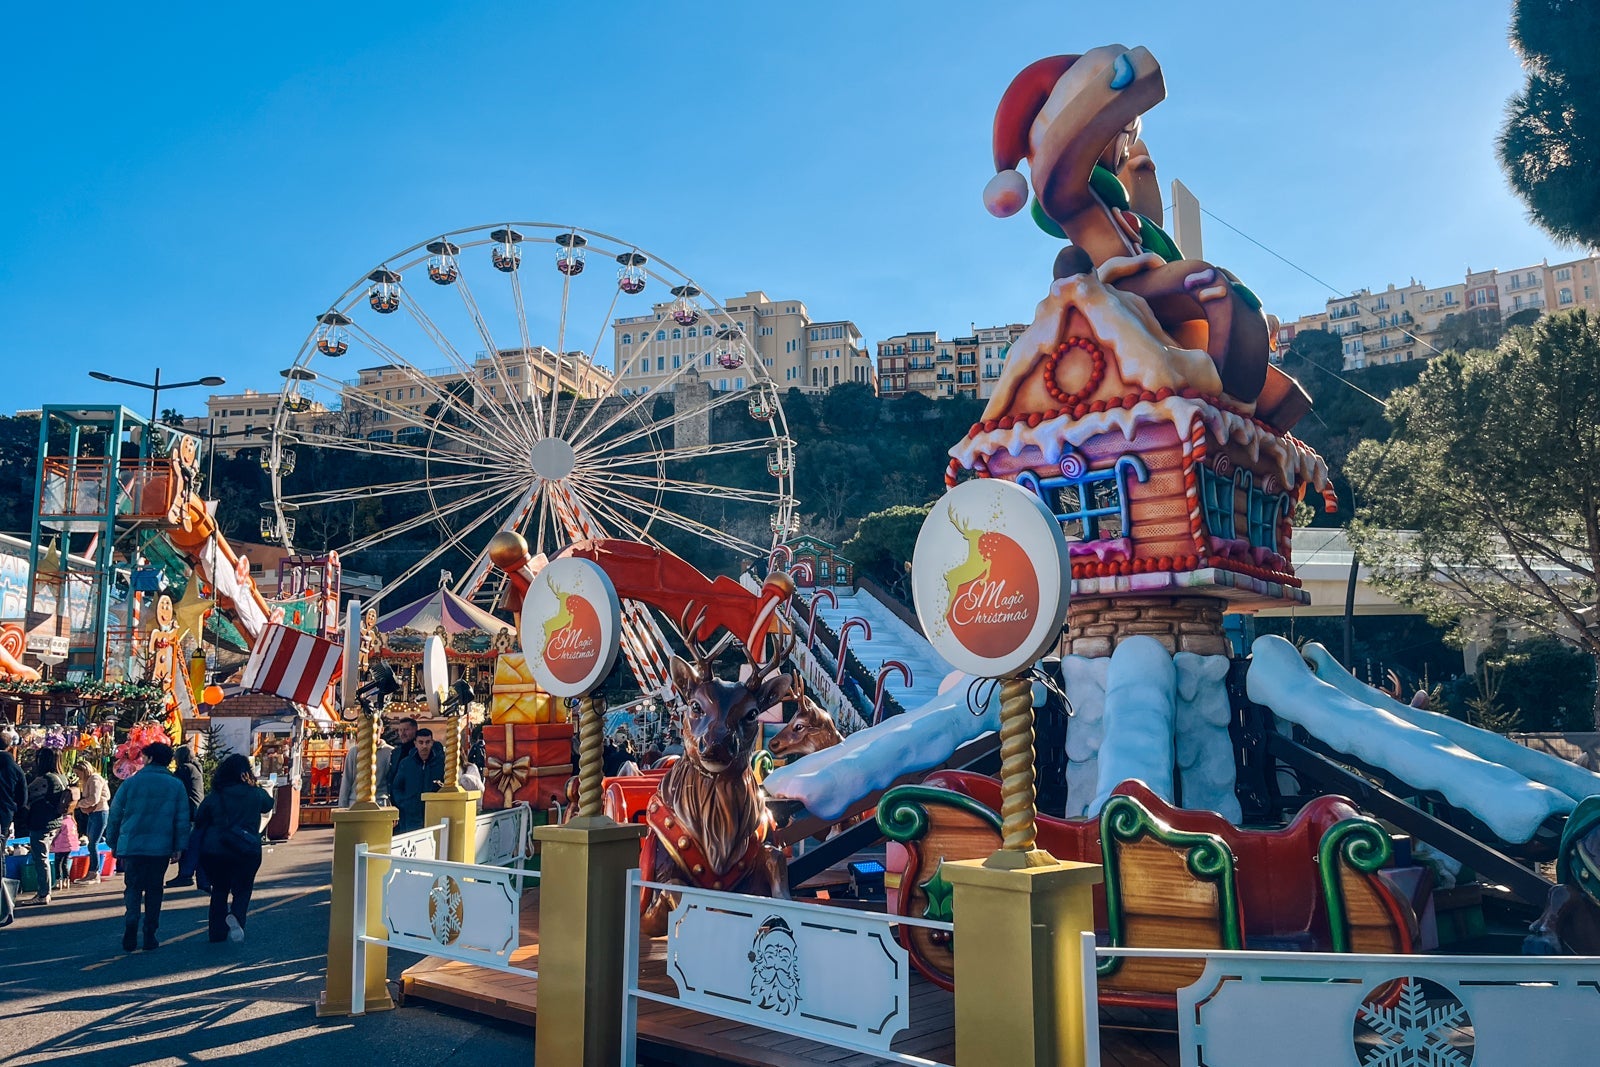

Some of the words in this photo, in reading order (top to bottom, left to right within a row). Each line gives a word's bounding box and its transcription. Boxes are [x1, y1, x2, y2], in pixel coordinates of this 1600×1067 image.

[964, 578, 1025, 610] Magic
[952, 591, 1030, 626] Christmas
[546, 636, 596, 661] Christmas
[554, 627, 594, 651] Magic
